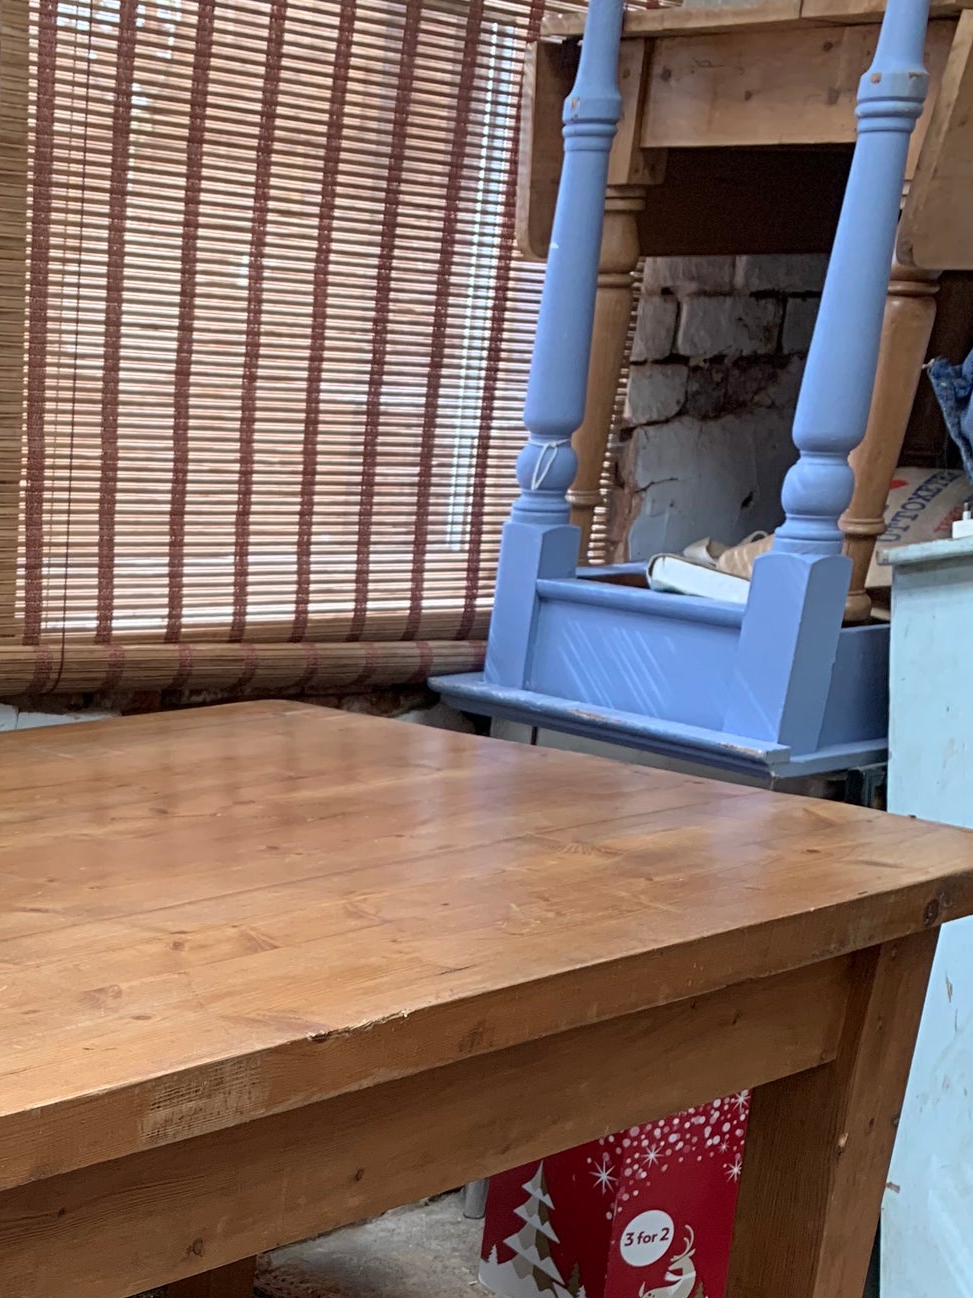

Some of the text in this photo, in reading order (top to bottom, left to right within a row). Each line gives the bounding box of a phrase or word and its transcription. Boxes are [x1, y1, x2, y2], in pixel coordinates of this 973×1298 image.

[624, 1227, 670, 1247] 3 for 2
